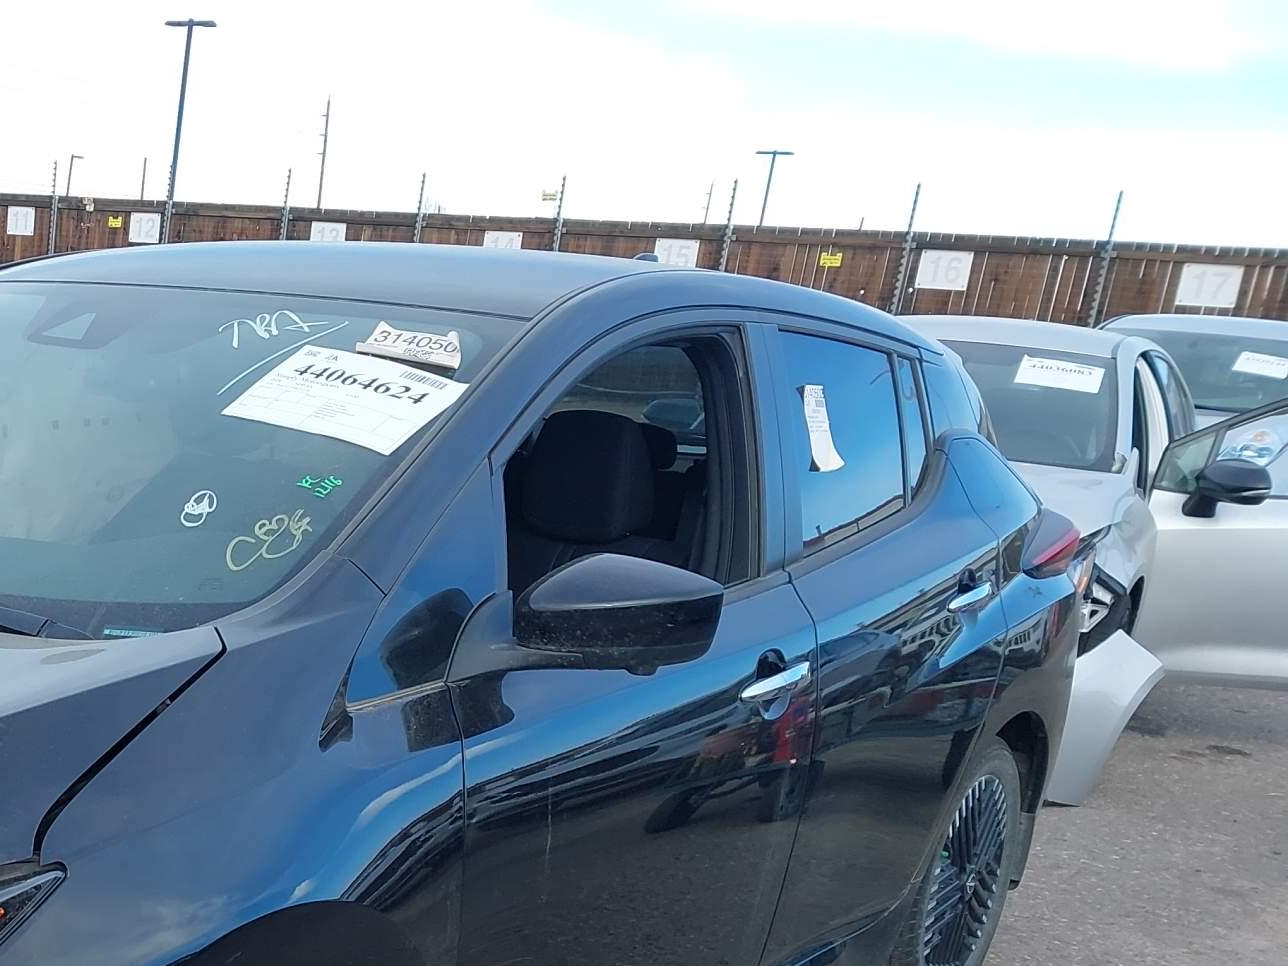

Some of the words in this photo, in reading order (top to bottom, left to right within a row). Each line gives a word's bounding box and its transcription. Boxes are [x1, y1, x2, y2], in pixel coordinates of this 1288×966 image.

[13, 211, 28, 231] 11
[135, 217, 155, 238] 12
[663, 244, 689, 266] 15
[929, 256, 962, 284] 16
[1192, 270, 1233, 300] 17
[293, 363, 429, 405] 44064624
